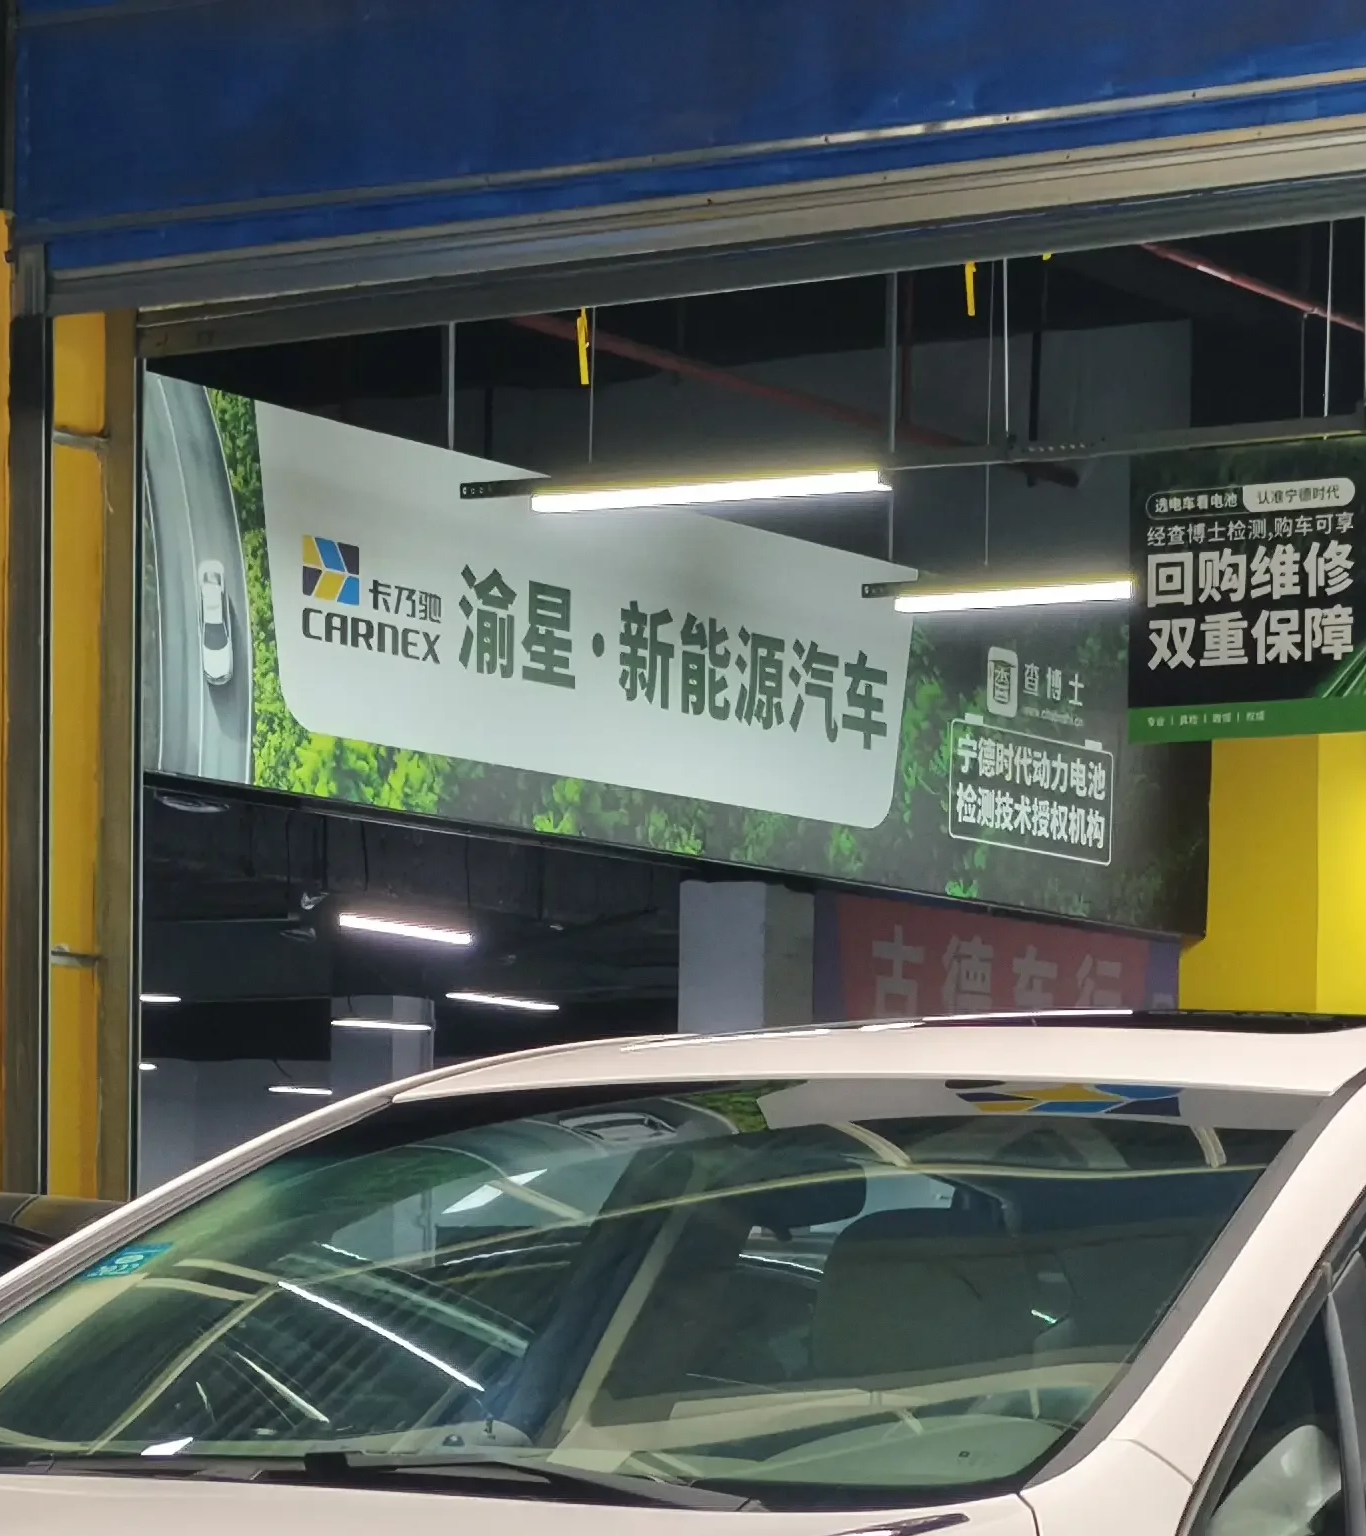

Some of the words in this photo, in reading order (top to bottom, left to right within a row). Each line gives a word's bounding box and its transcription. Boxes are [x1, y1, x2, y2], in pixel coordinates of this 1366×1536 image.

[1147, 512, 1355, 547] 经查博士检测,购车可享
[369, 579, 442, 623] 卡乃驰
[1147, 540, 1355, 608] 回购维修
[302, 607, 441, 664] CARNEX
[458, 563, 888, 750] 渝星·新能源汽车
[1148, 604, 1355, 671] 双重保障
[1023, 662, 1084, 706] 查博士
[956, 736, 1106, 800] 宁德时代动力电池
[956, 781, 1105, 848] 检测技术授权机构
